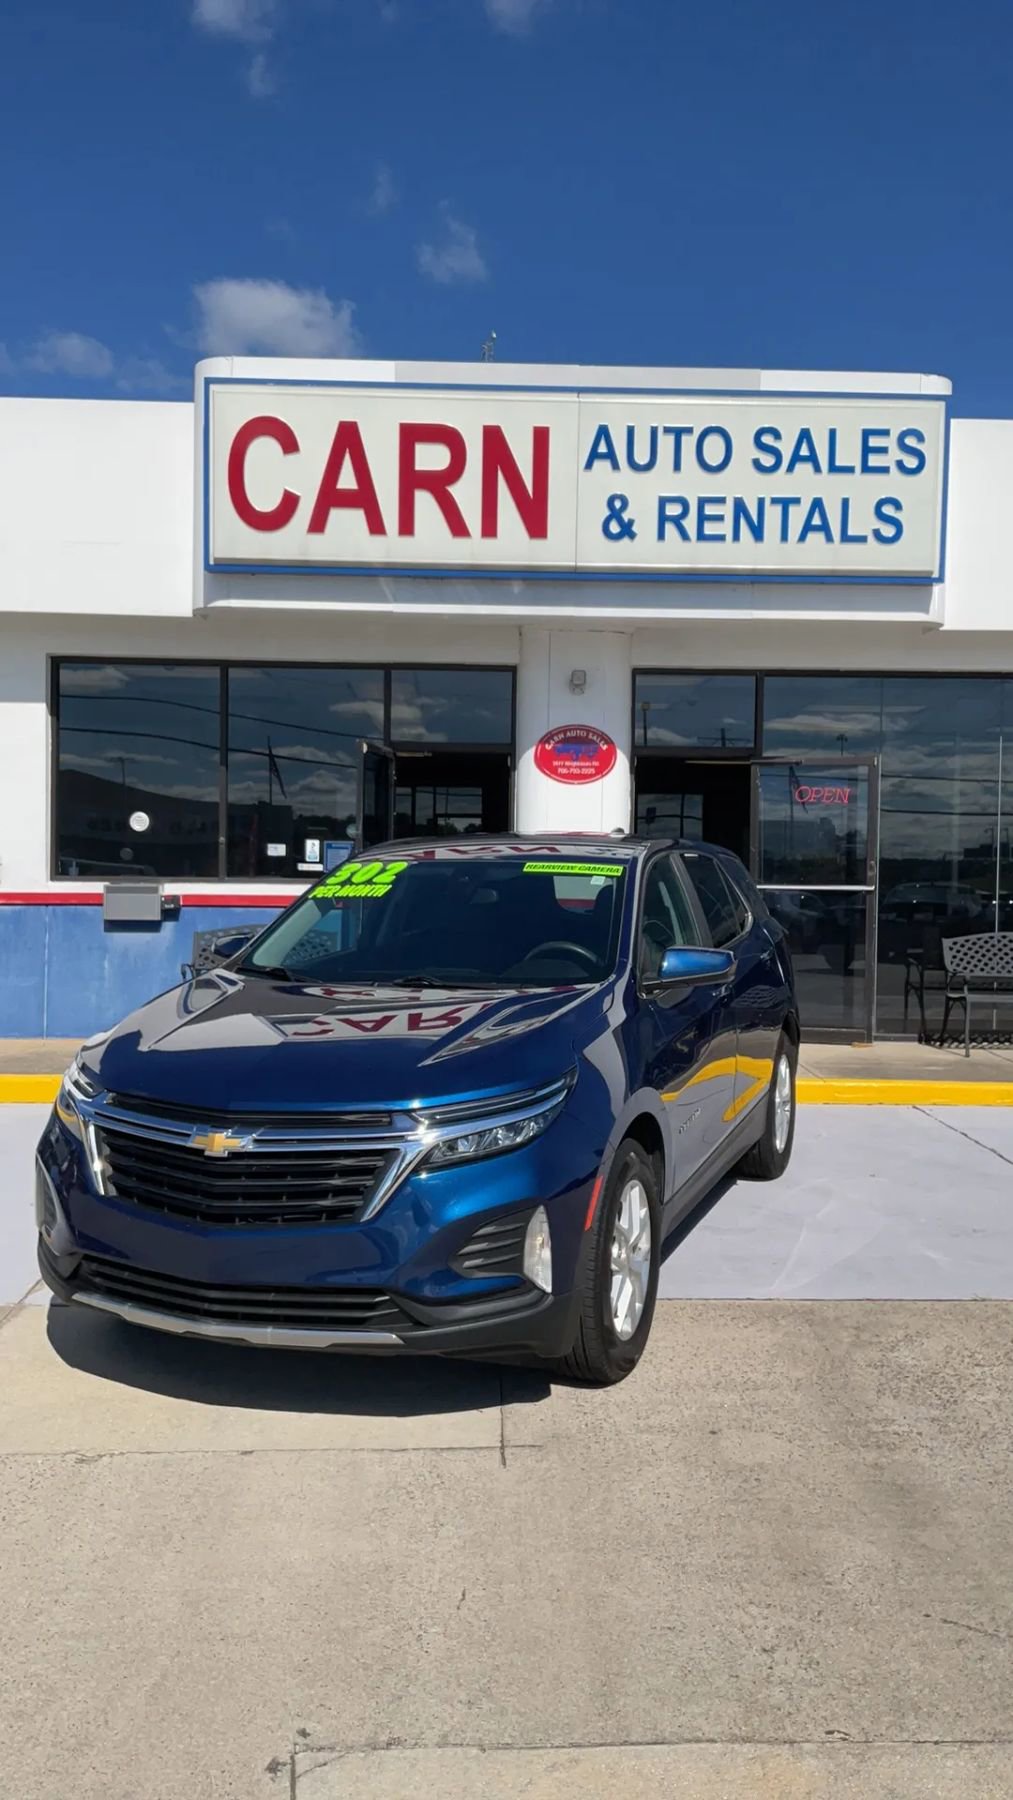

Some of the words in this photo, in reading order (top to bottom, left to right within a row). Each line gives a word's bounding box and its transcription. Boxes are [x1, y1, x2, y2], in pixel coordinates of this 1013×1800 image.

[584, 424, 735, 474] AUTO
[751, 424, 928, 477] SALES
[227, 415, 551, 540] CARN
[601, 494, 638, 543] &
[657, 495, 905, 546] RENTALS
[566, 729, 586, 737] AUTO
[588, 733, 608, 750] SALES
[795, 785, 851, 805] OPEN
[326, 861, 409, 885] 302
[525, 863, 577, 871] REARVIEW
[578, 865, 621, 874] CAMERA
[308, 885, 341, 898] PER
[334, 884, 393, 898] MONTH
